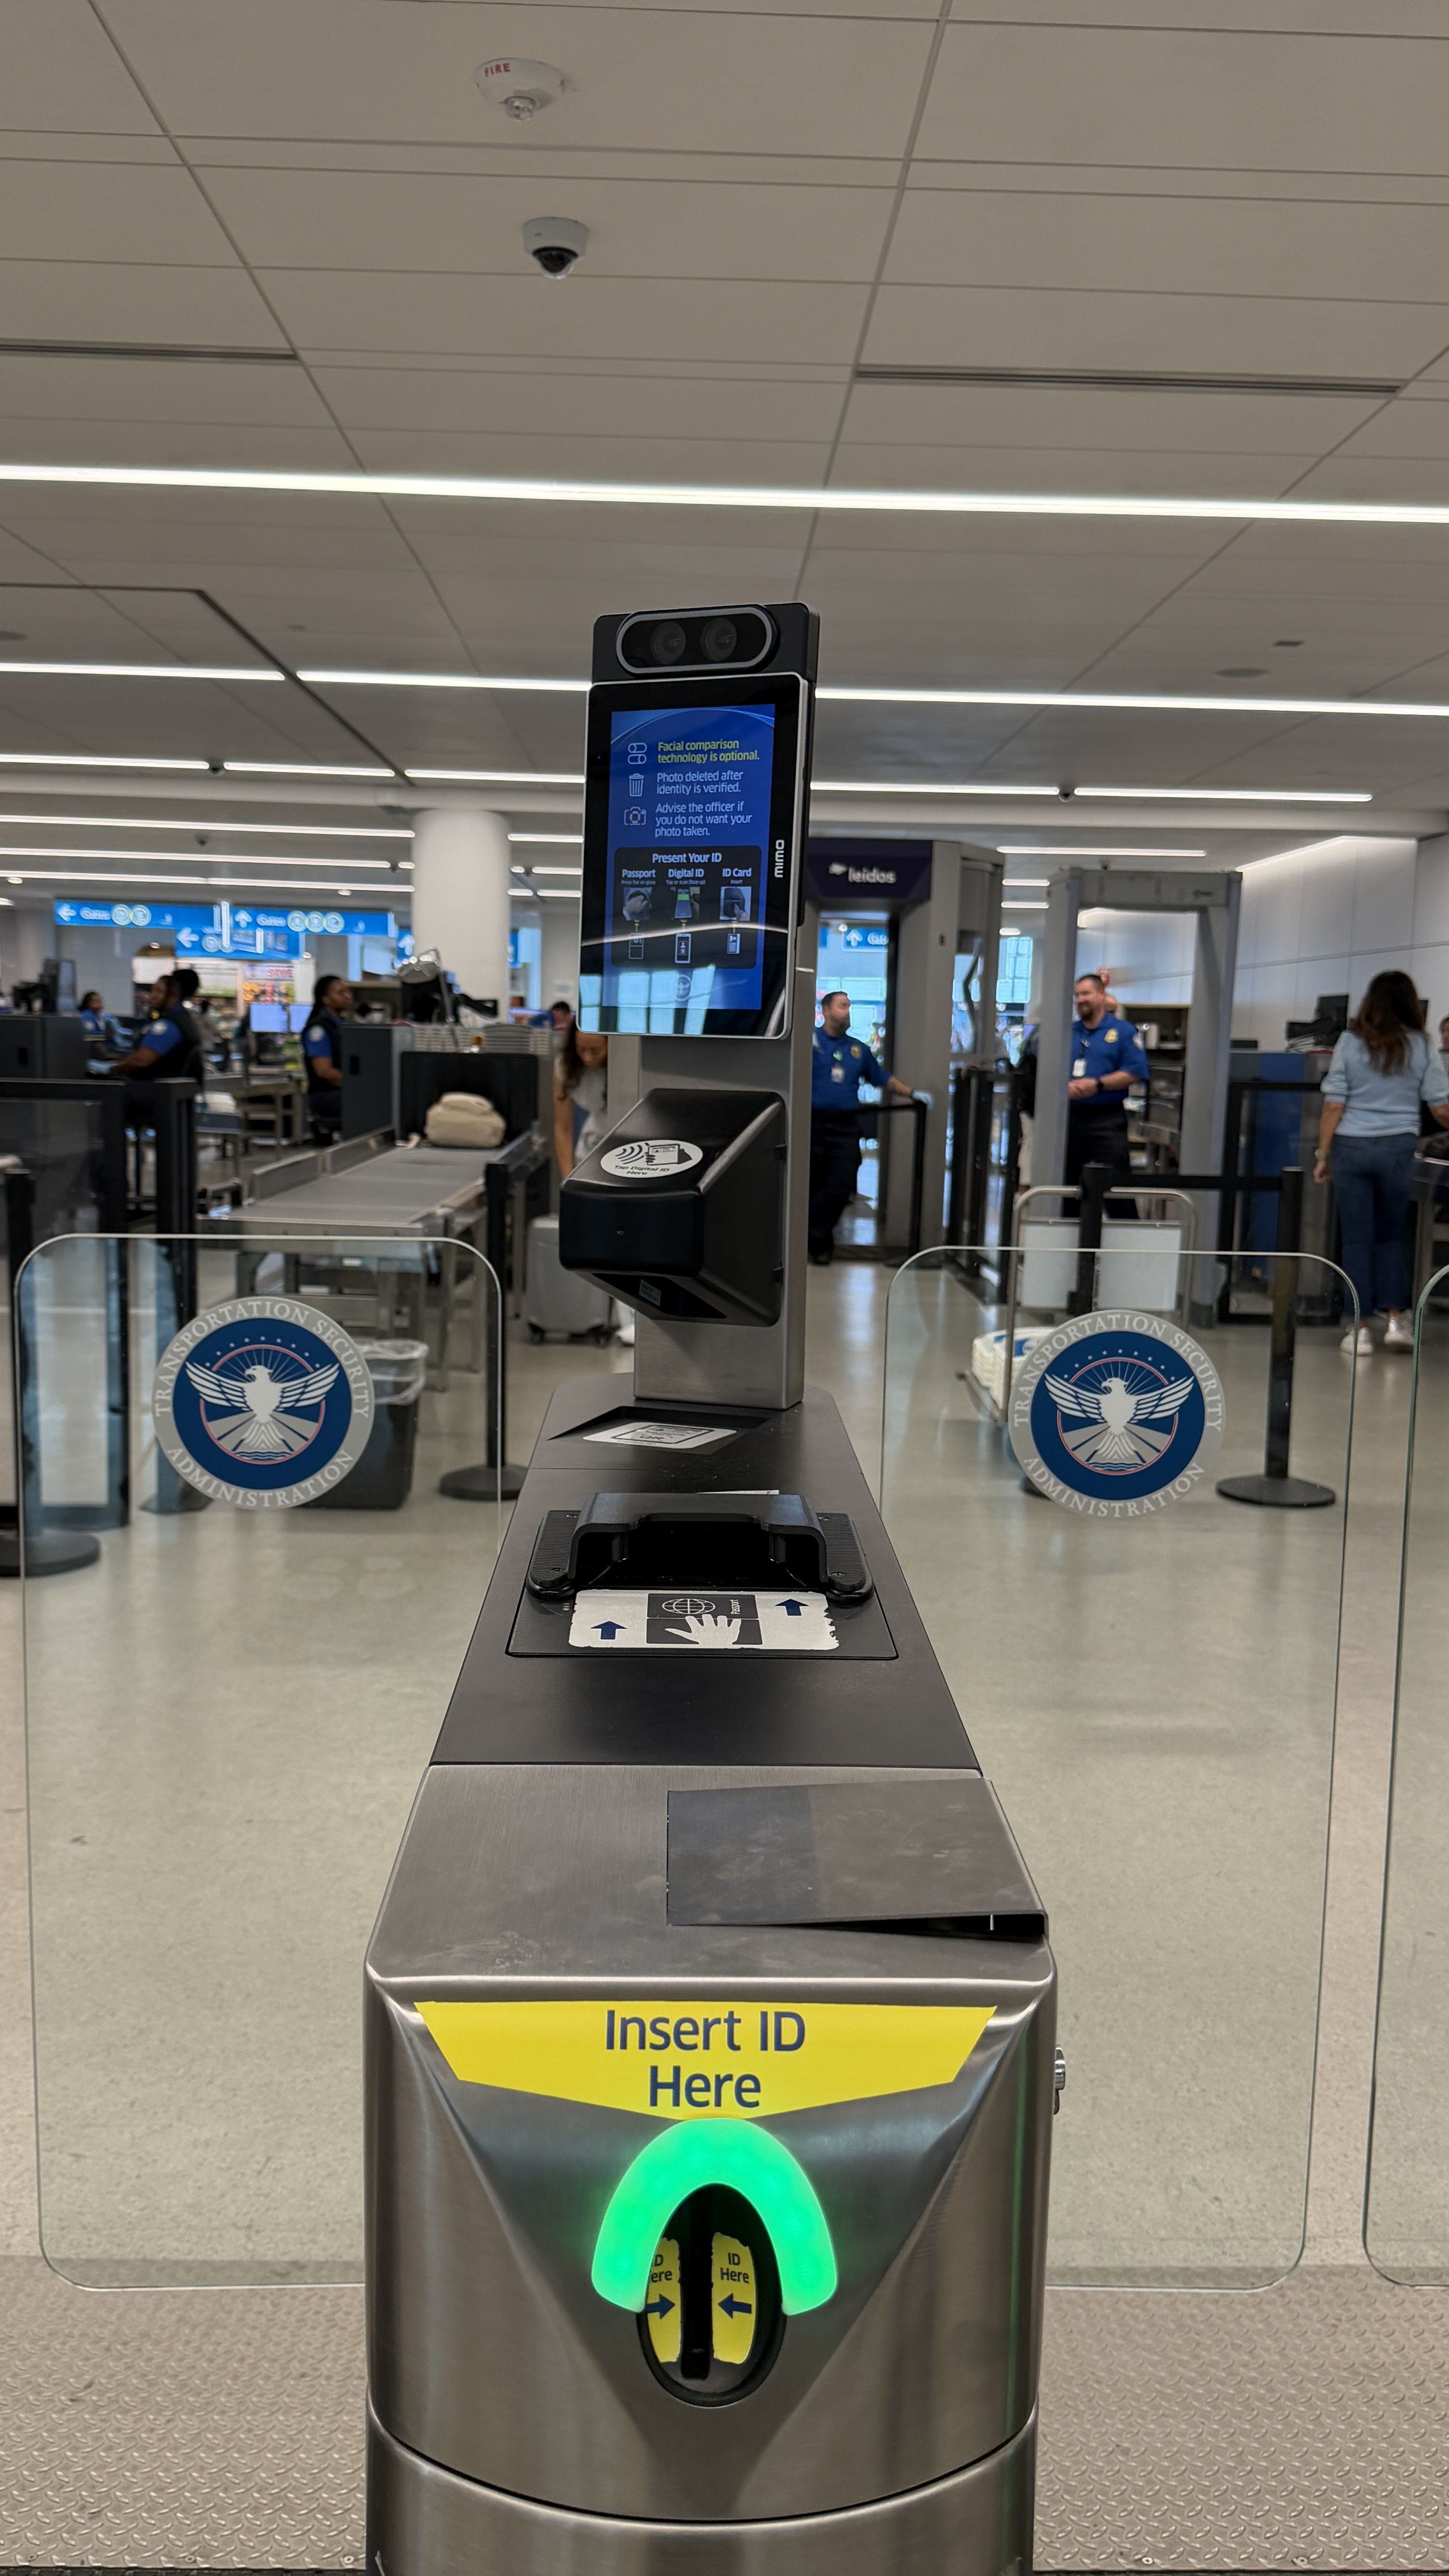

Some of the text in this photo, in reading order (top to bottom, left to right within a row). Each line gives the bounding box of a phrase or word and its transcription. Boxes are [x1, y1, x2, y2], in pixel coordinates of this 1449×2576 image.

[484, 63, 511, 77] FIRE
[658, 739, 739, 751] Facial comparison
[658, 750, 759, 764] technology is optional.
[657, 770, 743, 782] Photo deleted after
[657, 782, 741, 795] identity is verified.
[656, 801, 745, 813] Advise the officer if
[656, 814, 752, 826] you do not want your
[655, 826, 710, 838] photo taken.
[652, 853, 722, 863] Present Your ID
[774, 840, 785, 878] mimo
[622, 869, 656, 879] Passport
[668, 869, 704, 879] Digital ID
[722, 868, 752, 877] ID Card
[848, 866, 896, 883] leidos
[156, 1301, 369, 1418] TRANSPORTATION SECURITY
[1014, 1314, 1223, 1431] TRANSPORTATION SECURITY
[167, 1447, 353, 1507] ADMINISTRATION
[1024, 1458, 1204, 1518] ADMINISTRATION
[606, 2010, 805, 2051] Insert ID
[649, 2065, 761, 2108] Here
[652, 2254, 664, 2267] D
[727, 2252, 741, 2266] ID
[649, 2270, 672, 2282] ere
[720, 2267, 750, 2284] Here
